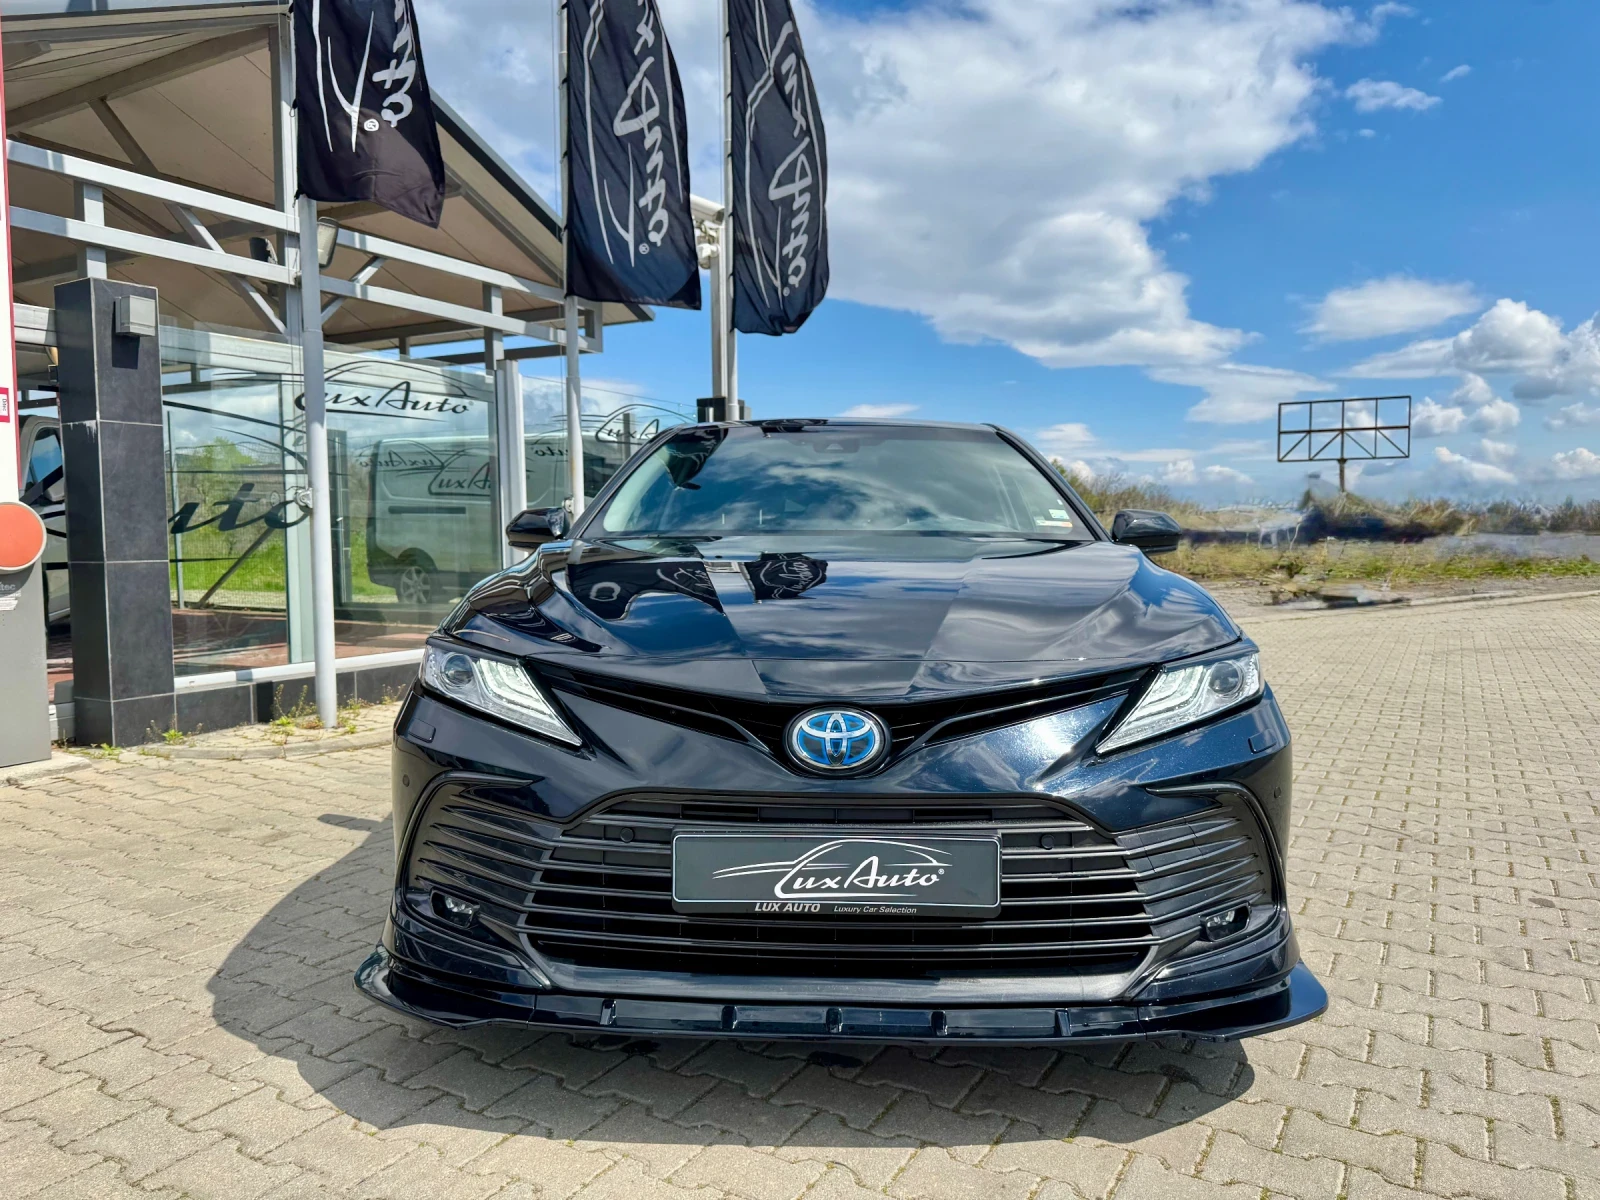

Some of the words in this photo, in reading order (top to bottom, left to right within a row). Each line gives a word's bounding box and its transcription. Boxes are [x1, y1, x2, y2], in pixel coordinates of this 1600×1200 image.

[754, 902, 781, 912] LUX
[783, 903, 821, 913] AUTO
[833, 905, 861, 914] Luxury
[863, 906, 878, 914] Car
[878, 906, 917, 914] Selection
